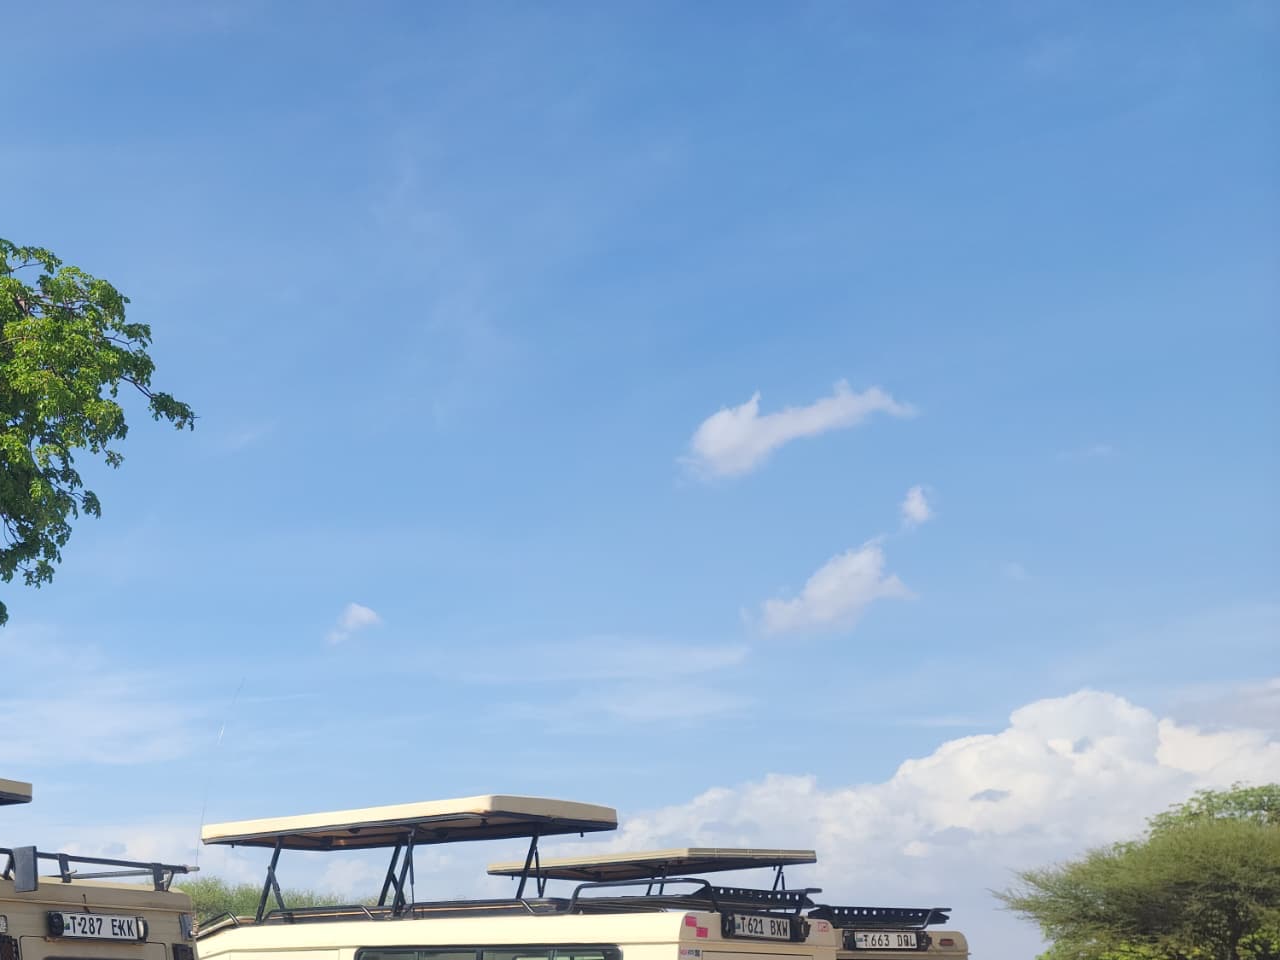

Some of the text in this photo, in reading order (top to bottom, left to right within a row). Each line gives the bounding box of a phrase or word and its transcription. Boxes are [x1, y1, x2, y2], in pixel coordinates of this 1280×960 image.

[69, 916, 134, 937] T 287 EKK
[740, 917, 746, 933] T
[748, 918, 764, 934] 621
[864, 934, 869, 947] T
[871, 934, 890, 947] 663
